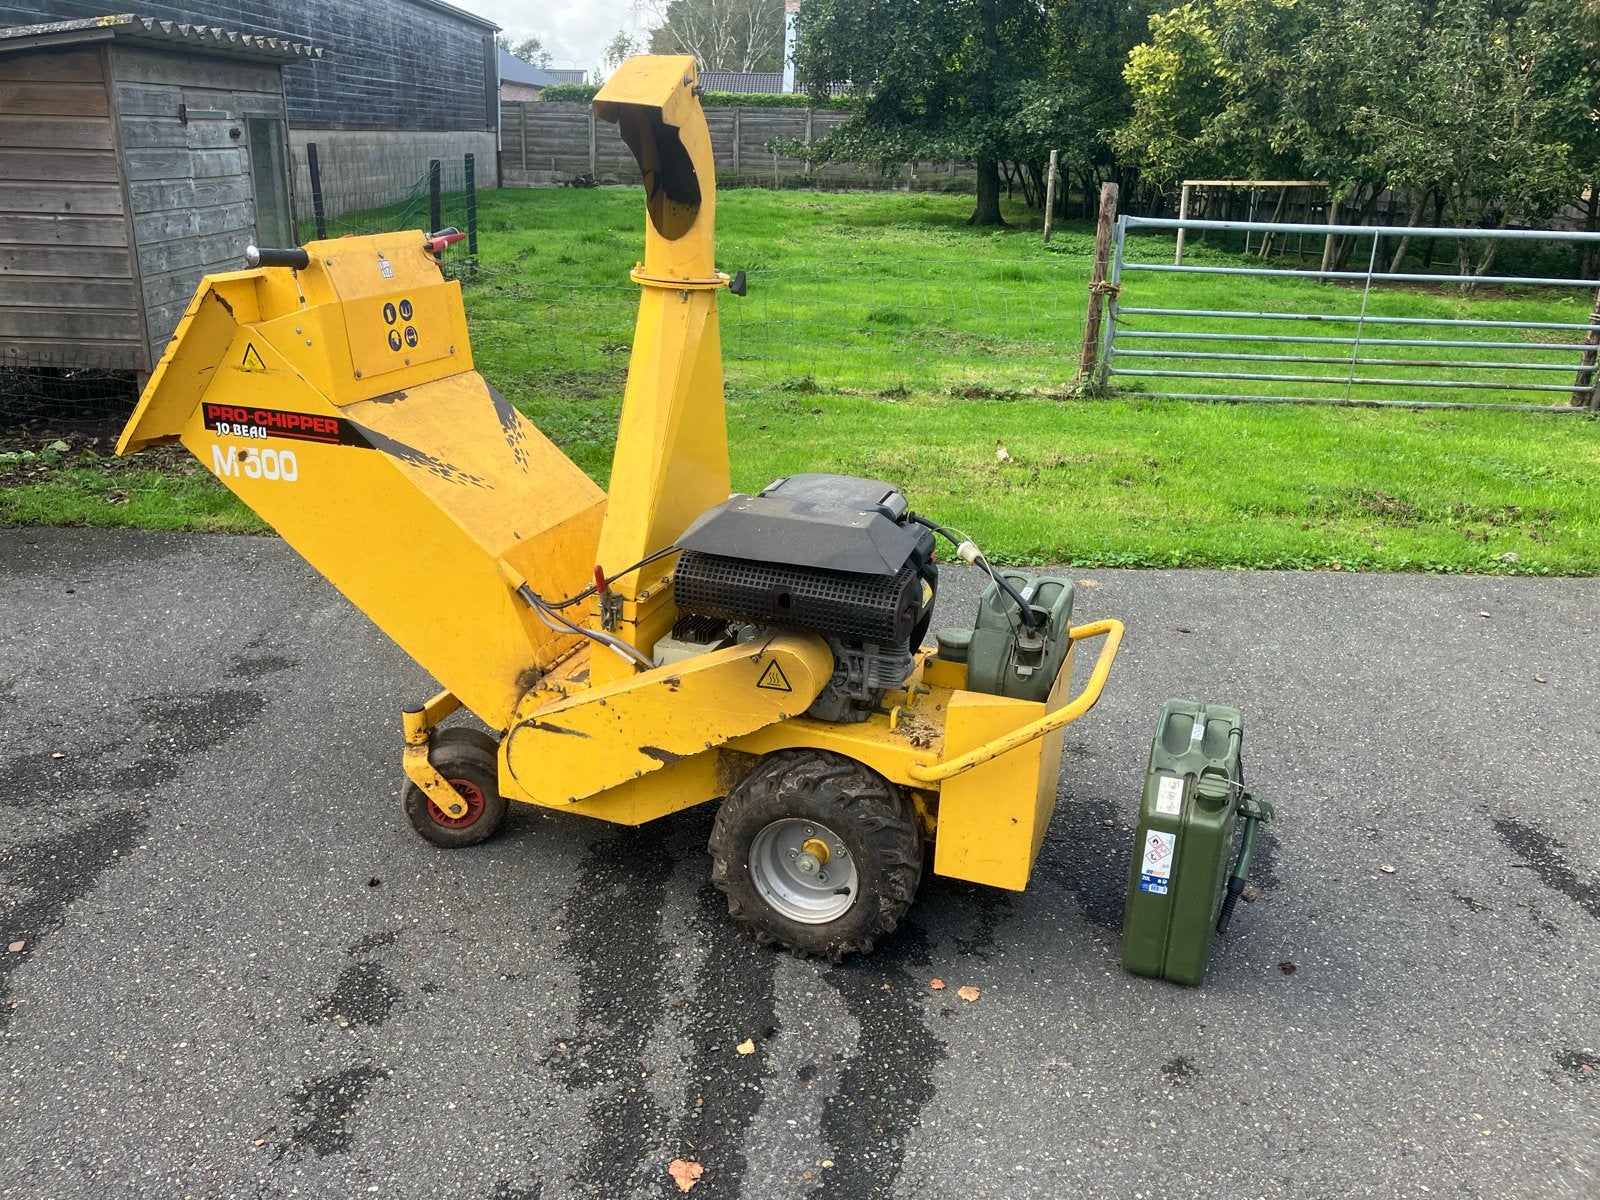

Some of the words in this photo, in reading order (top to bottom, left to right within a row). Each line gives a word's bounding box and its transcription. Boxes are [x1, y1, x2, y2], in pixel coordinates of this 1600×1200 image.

[207, 405, 339, 434] PRO-CHIPPER
[216, 422, 230, 437] JO
[233, 423, 267, 439] BEAU
